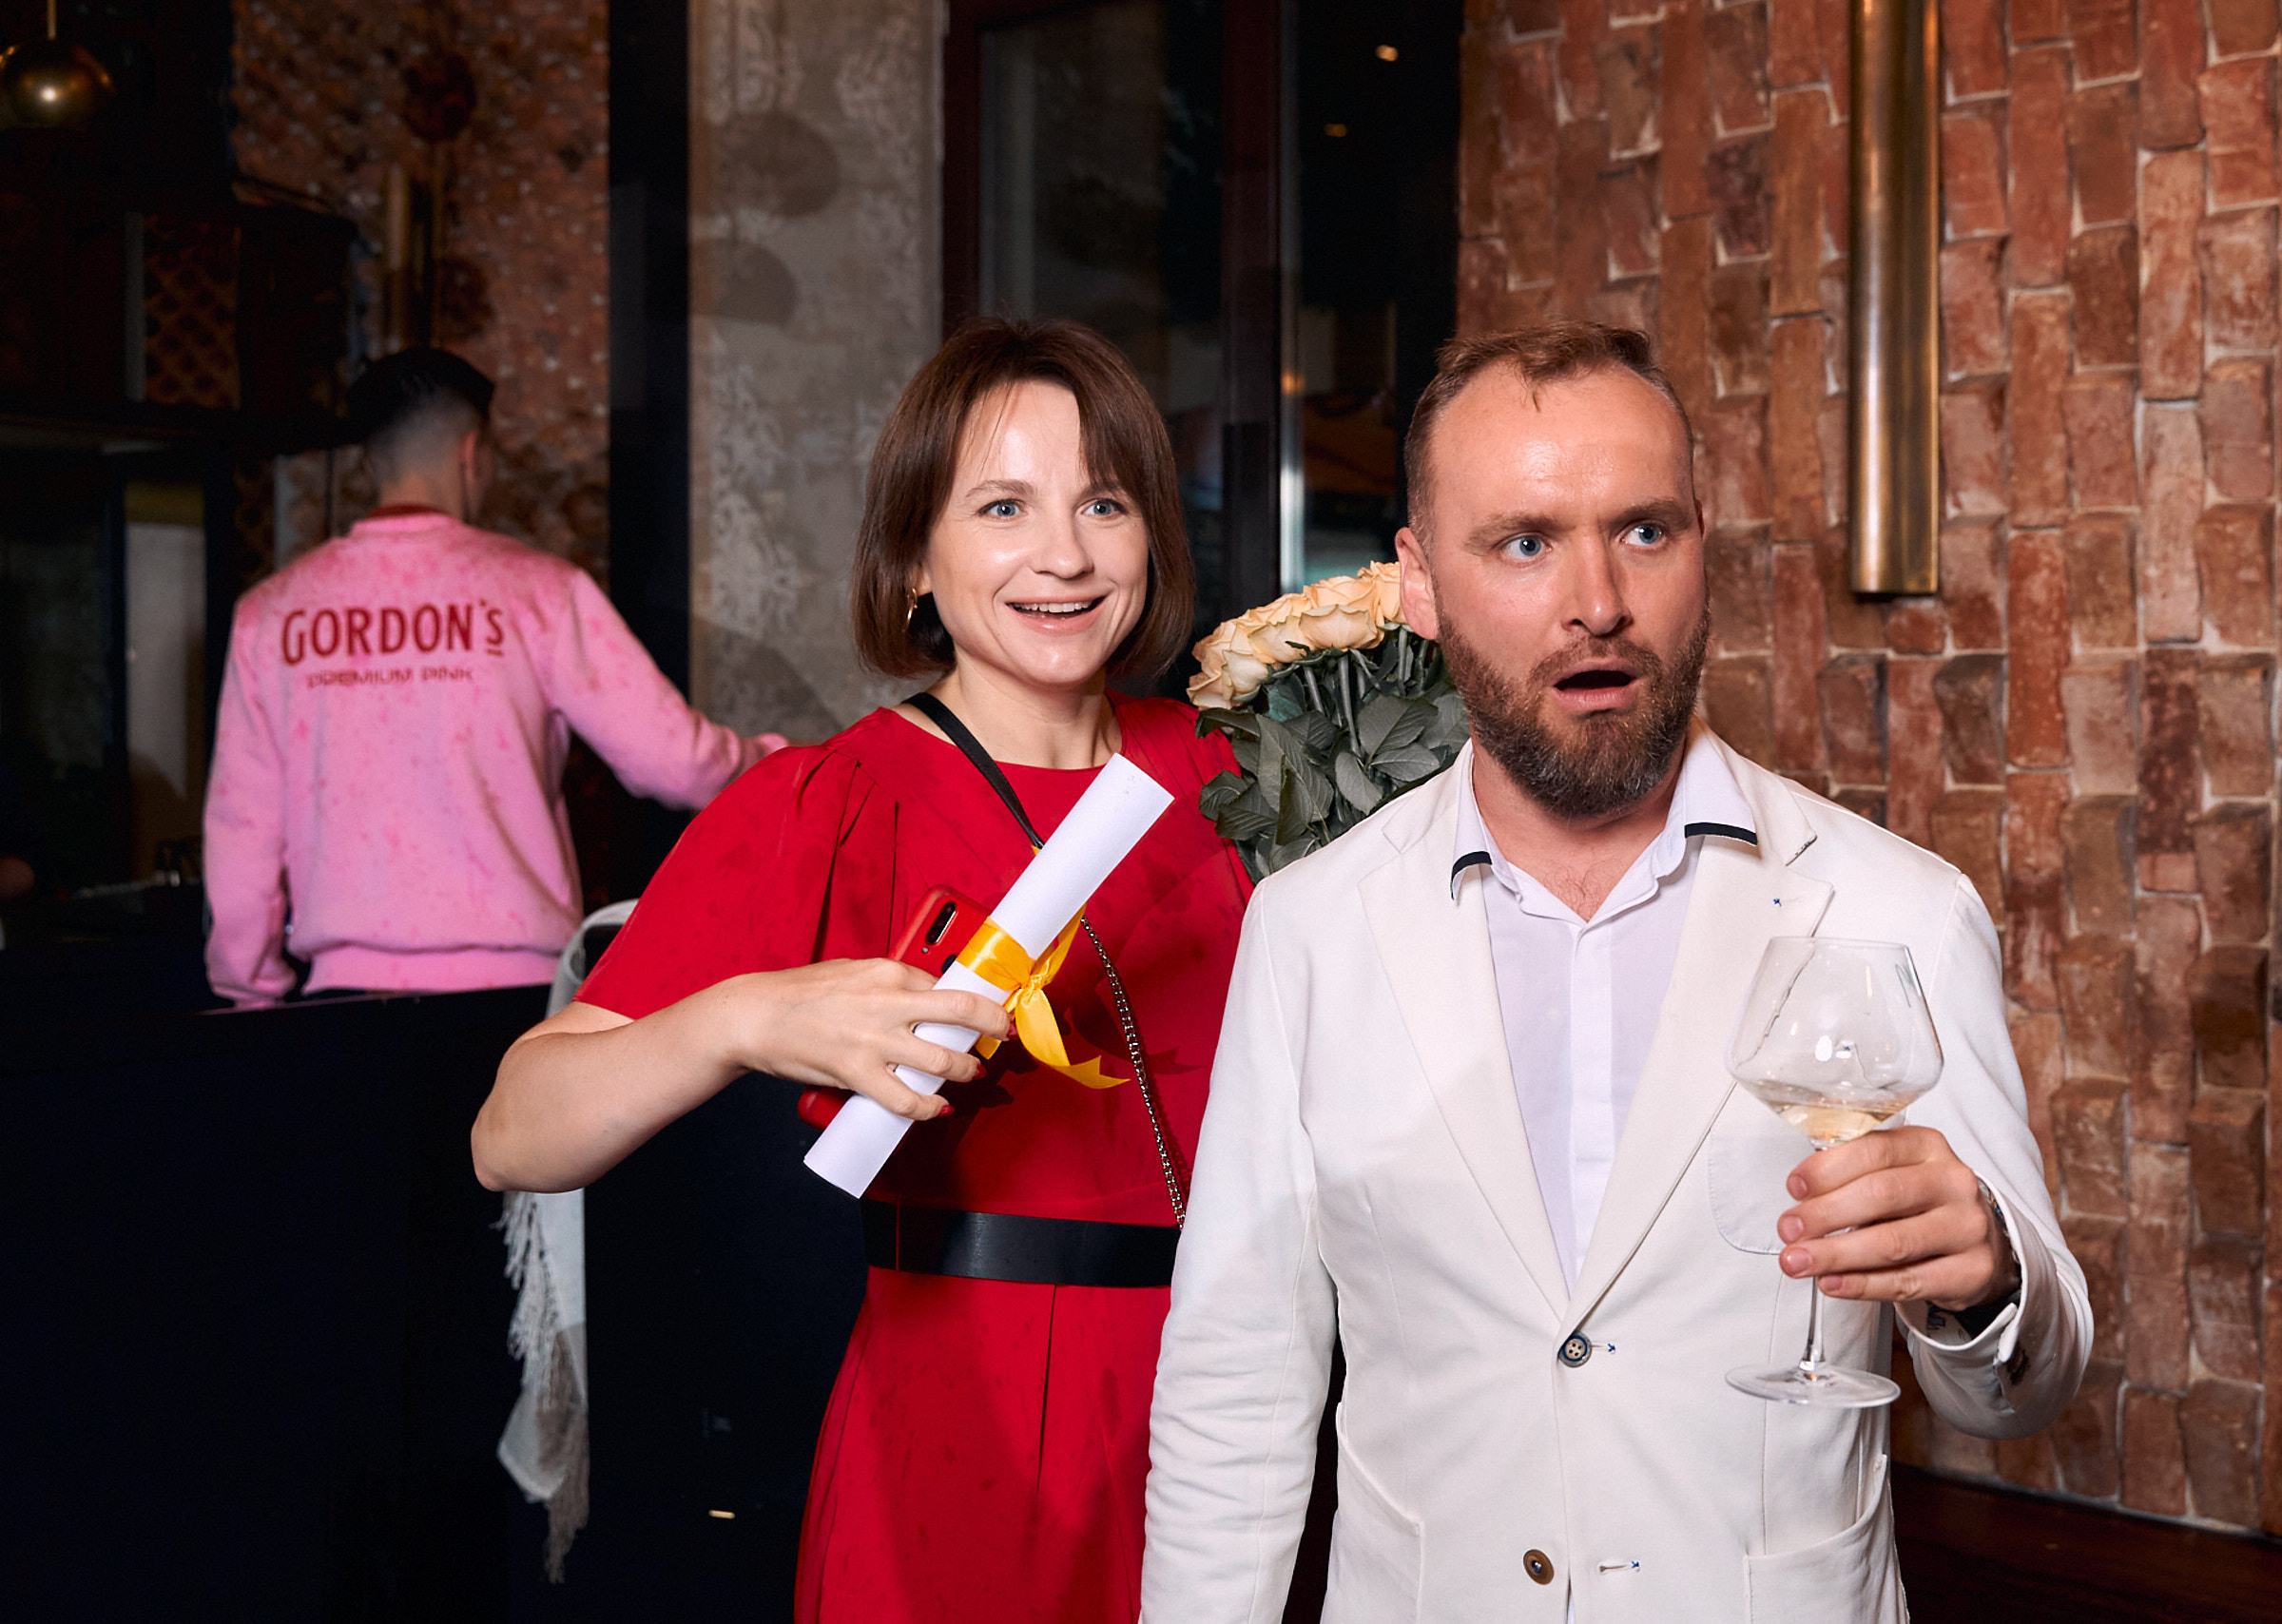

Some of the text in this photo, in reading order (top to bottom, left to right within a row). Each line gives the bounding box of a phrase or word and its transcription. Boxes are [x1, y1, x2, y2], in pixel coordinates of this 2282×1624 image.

[281, 599, 504, 666] GORDON'S
[305, 667, 474, 689] PREMIUM PINK
